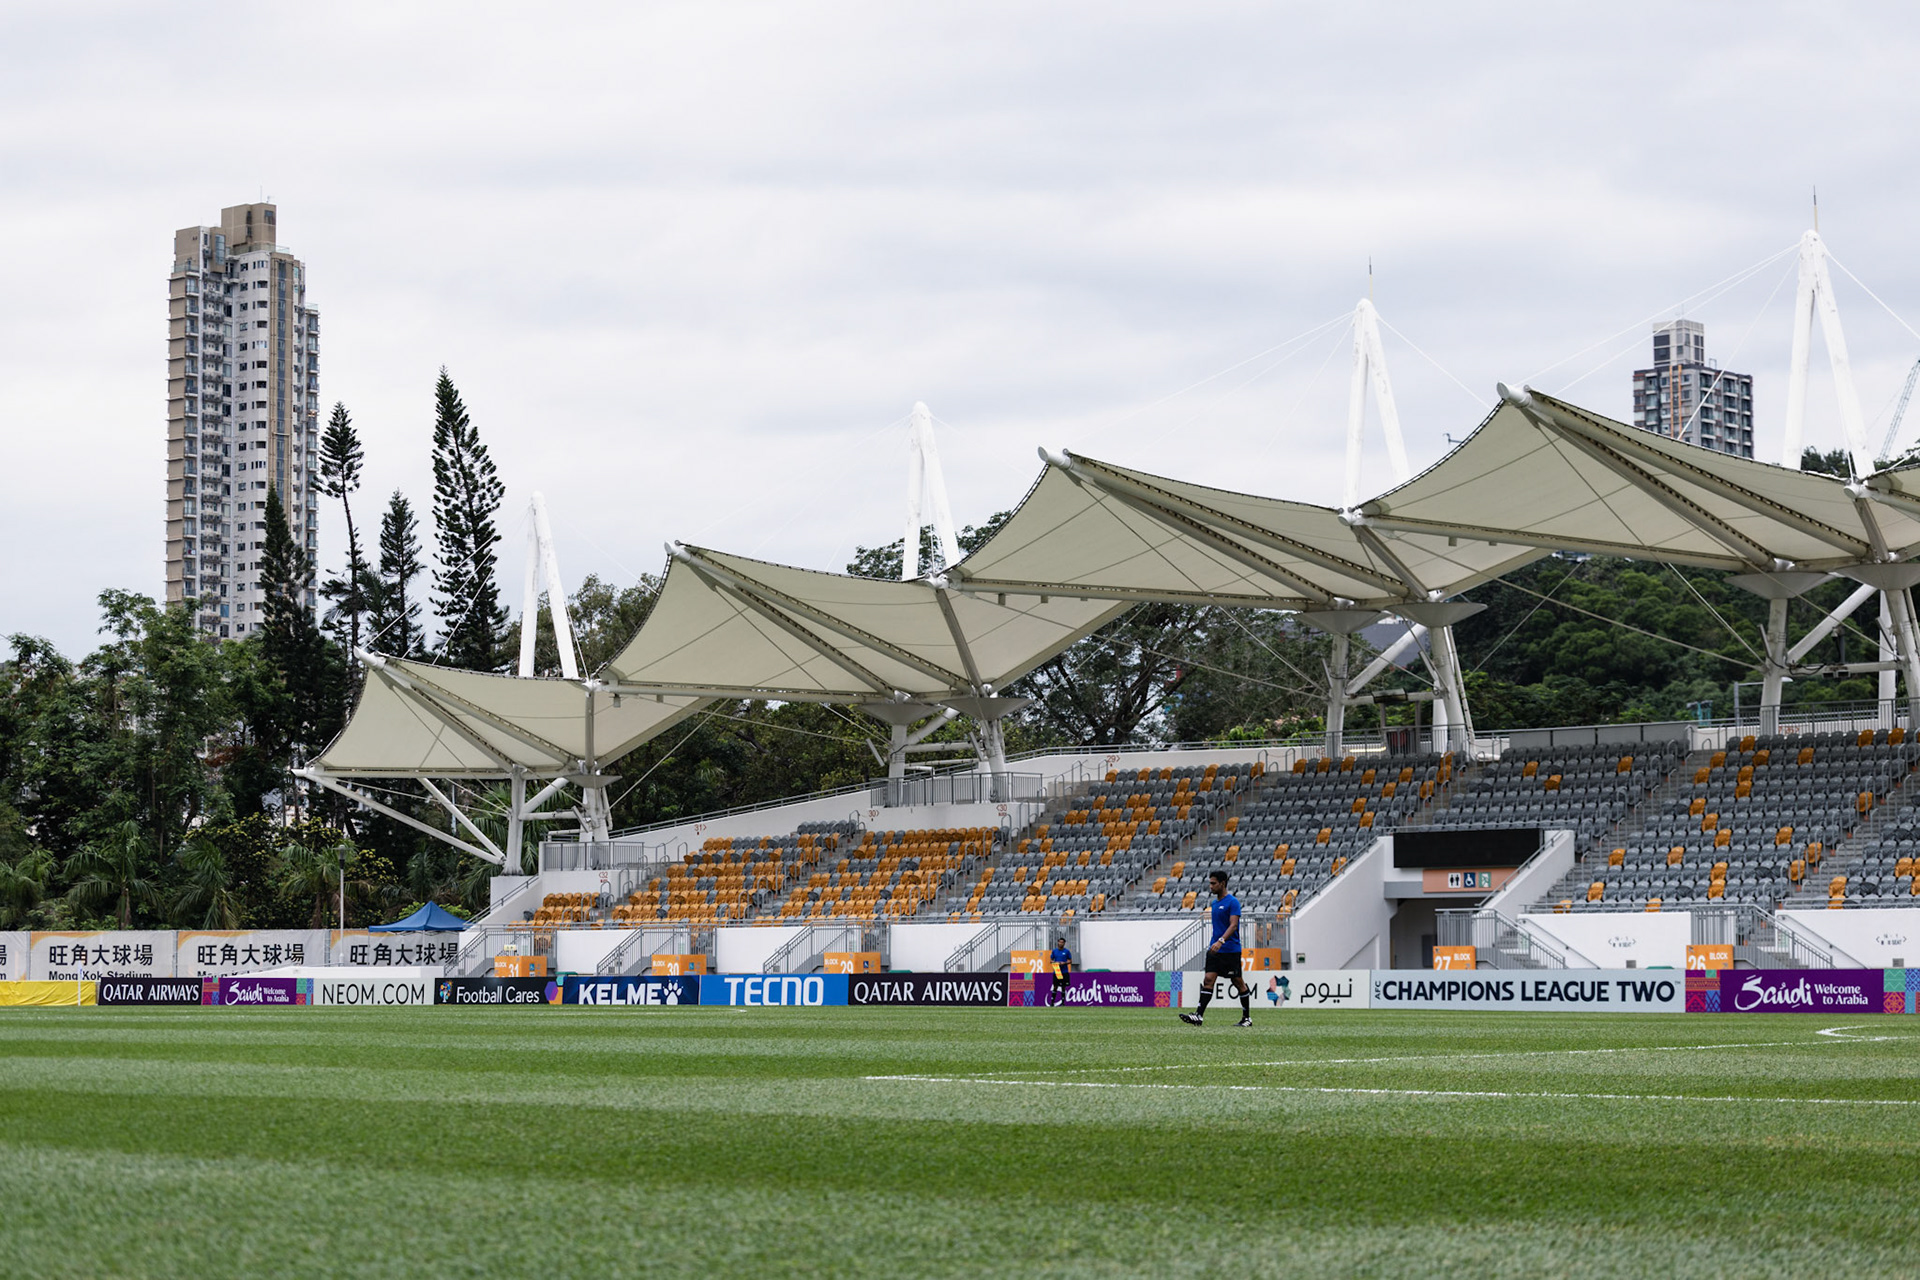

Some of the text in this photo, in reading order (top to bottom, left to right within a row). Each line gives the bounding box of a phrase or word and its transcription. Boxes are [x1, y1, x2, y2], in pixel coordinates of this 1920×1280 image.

[50, 943, 153, 966] 旺角大球場
[197, 942, 305, 966] 旺角大球場
[1453, 953, 1471, 961] BLOCK
[1709, 952, 1728, 960] BLOCK
[667, 962, 680, 975] 30
[840, 960, 853, 973] 29
[1029, 959, 1044, 973] 28
[1435, 956, 1451, 970] 27
[1688, 955, 1706, 969] 26
[508, 963, 519, 977] 31
[103, 983, 199, 1001] QATAR AIRWAYS
[263, 986, 286, 995] Welcome
[322, 983, 425, 1005] NEOM.COM
[456, 985, 540, 1003] Football Cares
[578, 983, 662, 1005] KELME
[724, 977, 824, 1006] TECNO
[854, 981, 1002, 1003] QATAR AIRWAYS
[1103, 984, 1138, 994] Welcome
[1200, 982, 1258, 1000] EOM
[1300, 978, 1352, 1003] نيوم
[1383, 980, 1675, 1002] CHAMPIONS LEAGUE TWO
[1814, 983, 1861, 994] Welcome
[274, 994, 290, 1002] Arabia
[1109, 993, 1143, 1003] to Arabia
[1822, 994, 1869, 1005] to Arabia
